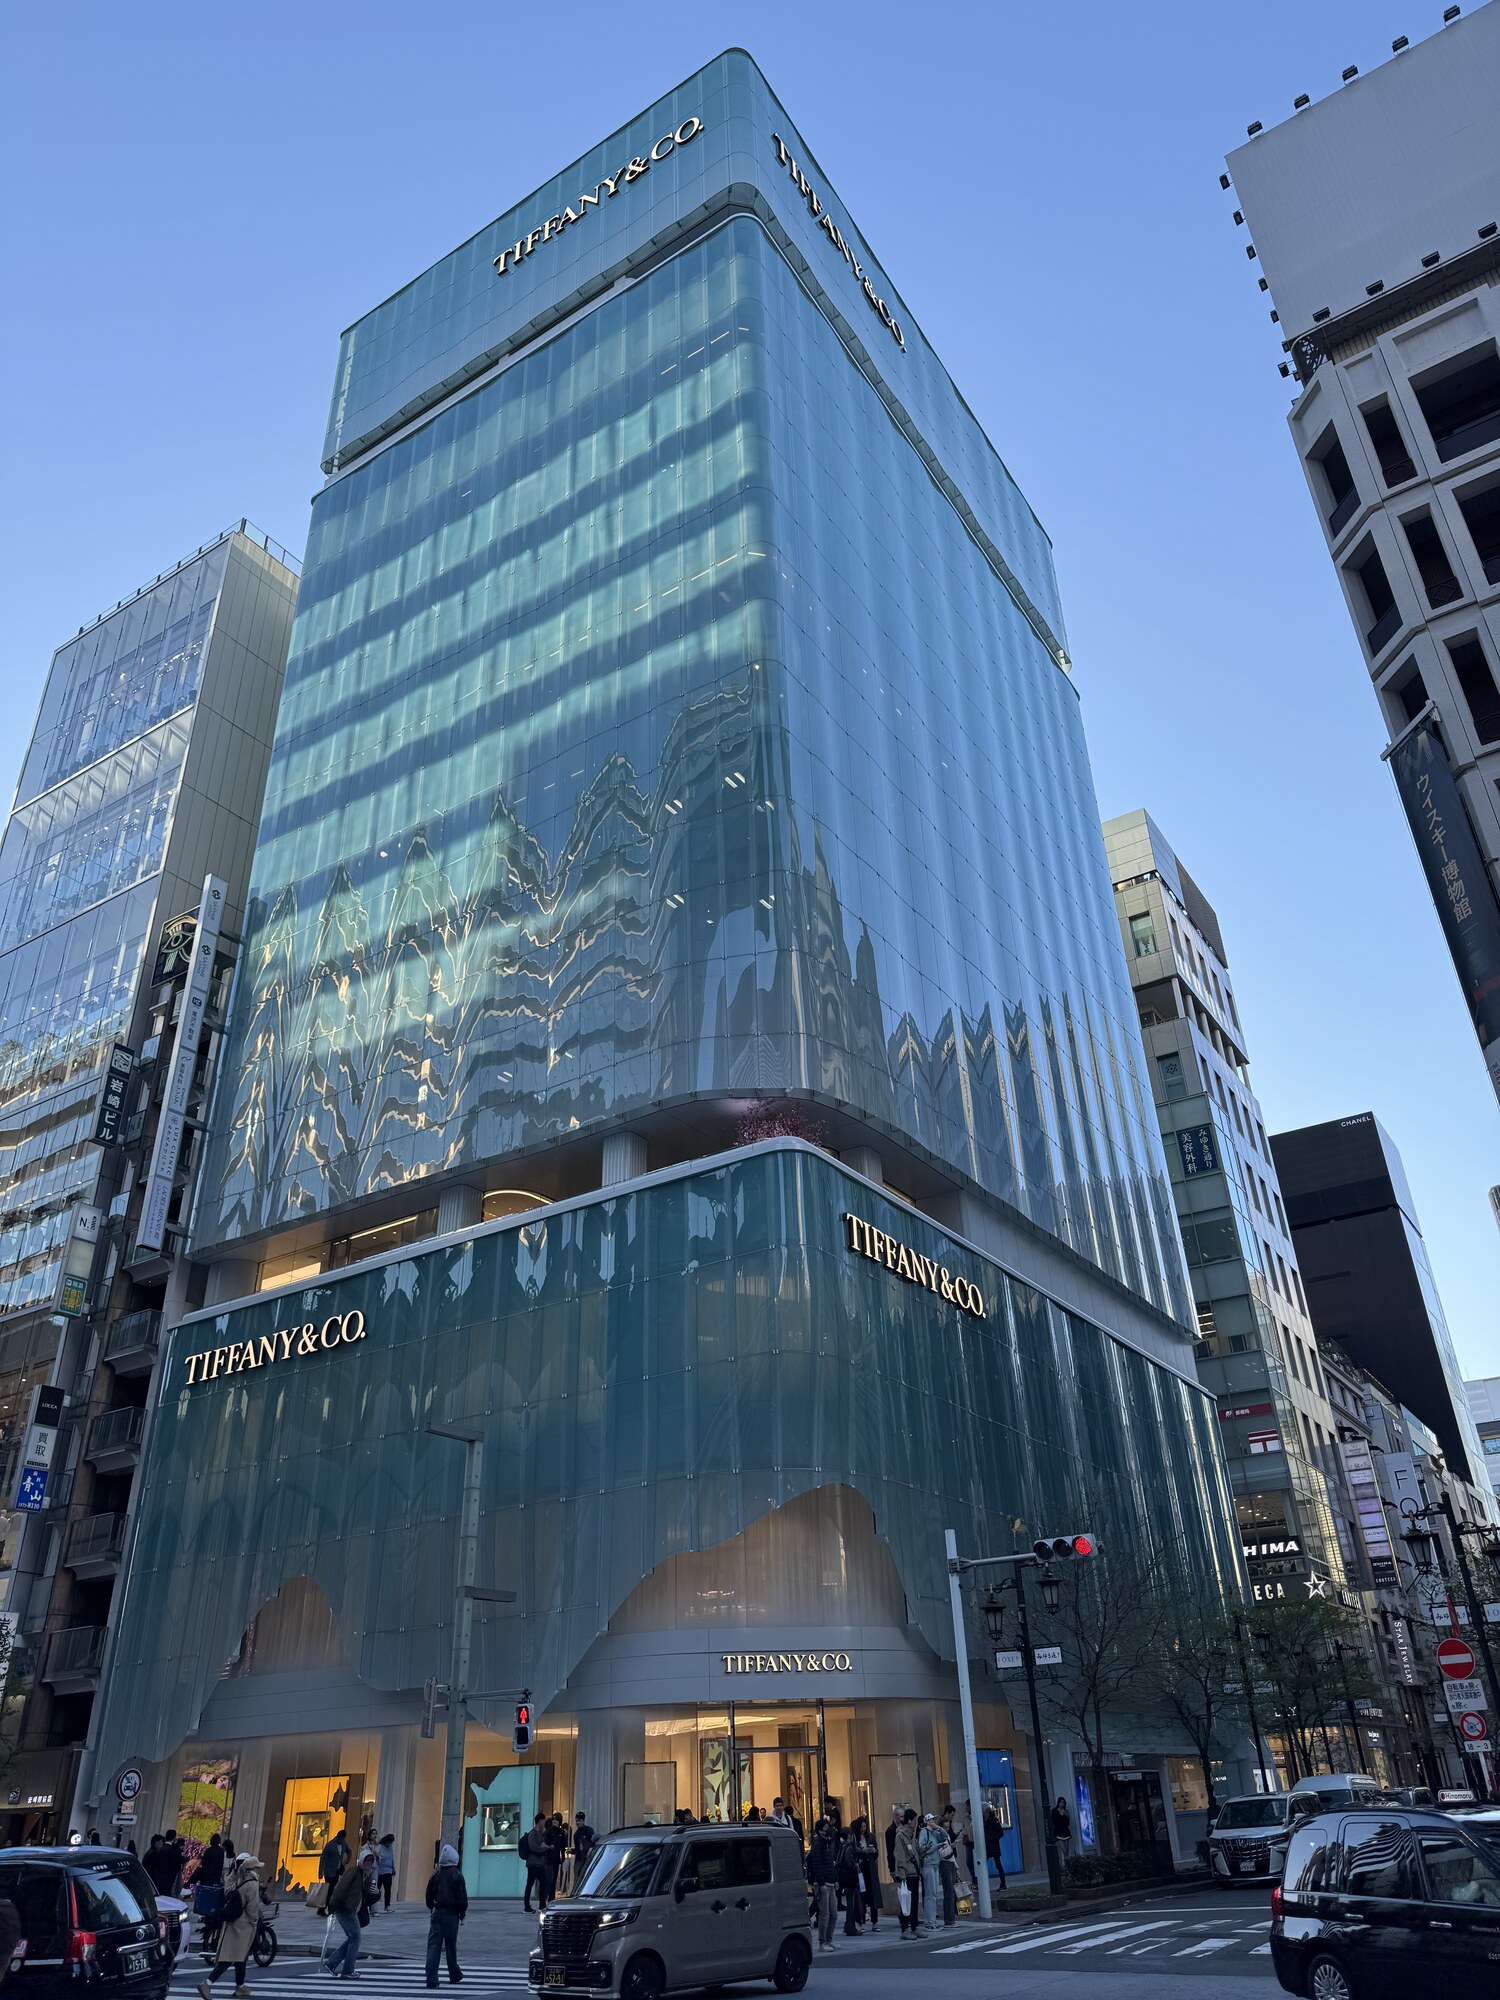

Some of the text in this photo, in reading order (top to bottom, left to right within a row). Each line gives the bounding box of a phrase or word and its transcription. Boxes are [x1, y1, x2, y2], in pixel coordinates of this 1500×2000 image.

[1416, 772, 1473, 924] ウイスキー博物館
[99, 1078, 124, 1141] 岩崎ビル
[1340, 1116, 1371, 1127] CHANEL
[1180, 1132, 1198, 1174] 美容外科
[1198, 1128, 1213, 1169] みゆき通り
[34, 1432, 49, 1457] 買取
[1394, 1621, 1414, 1685] STAR JEWELRY
